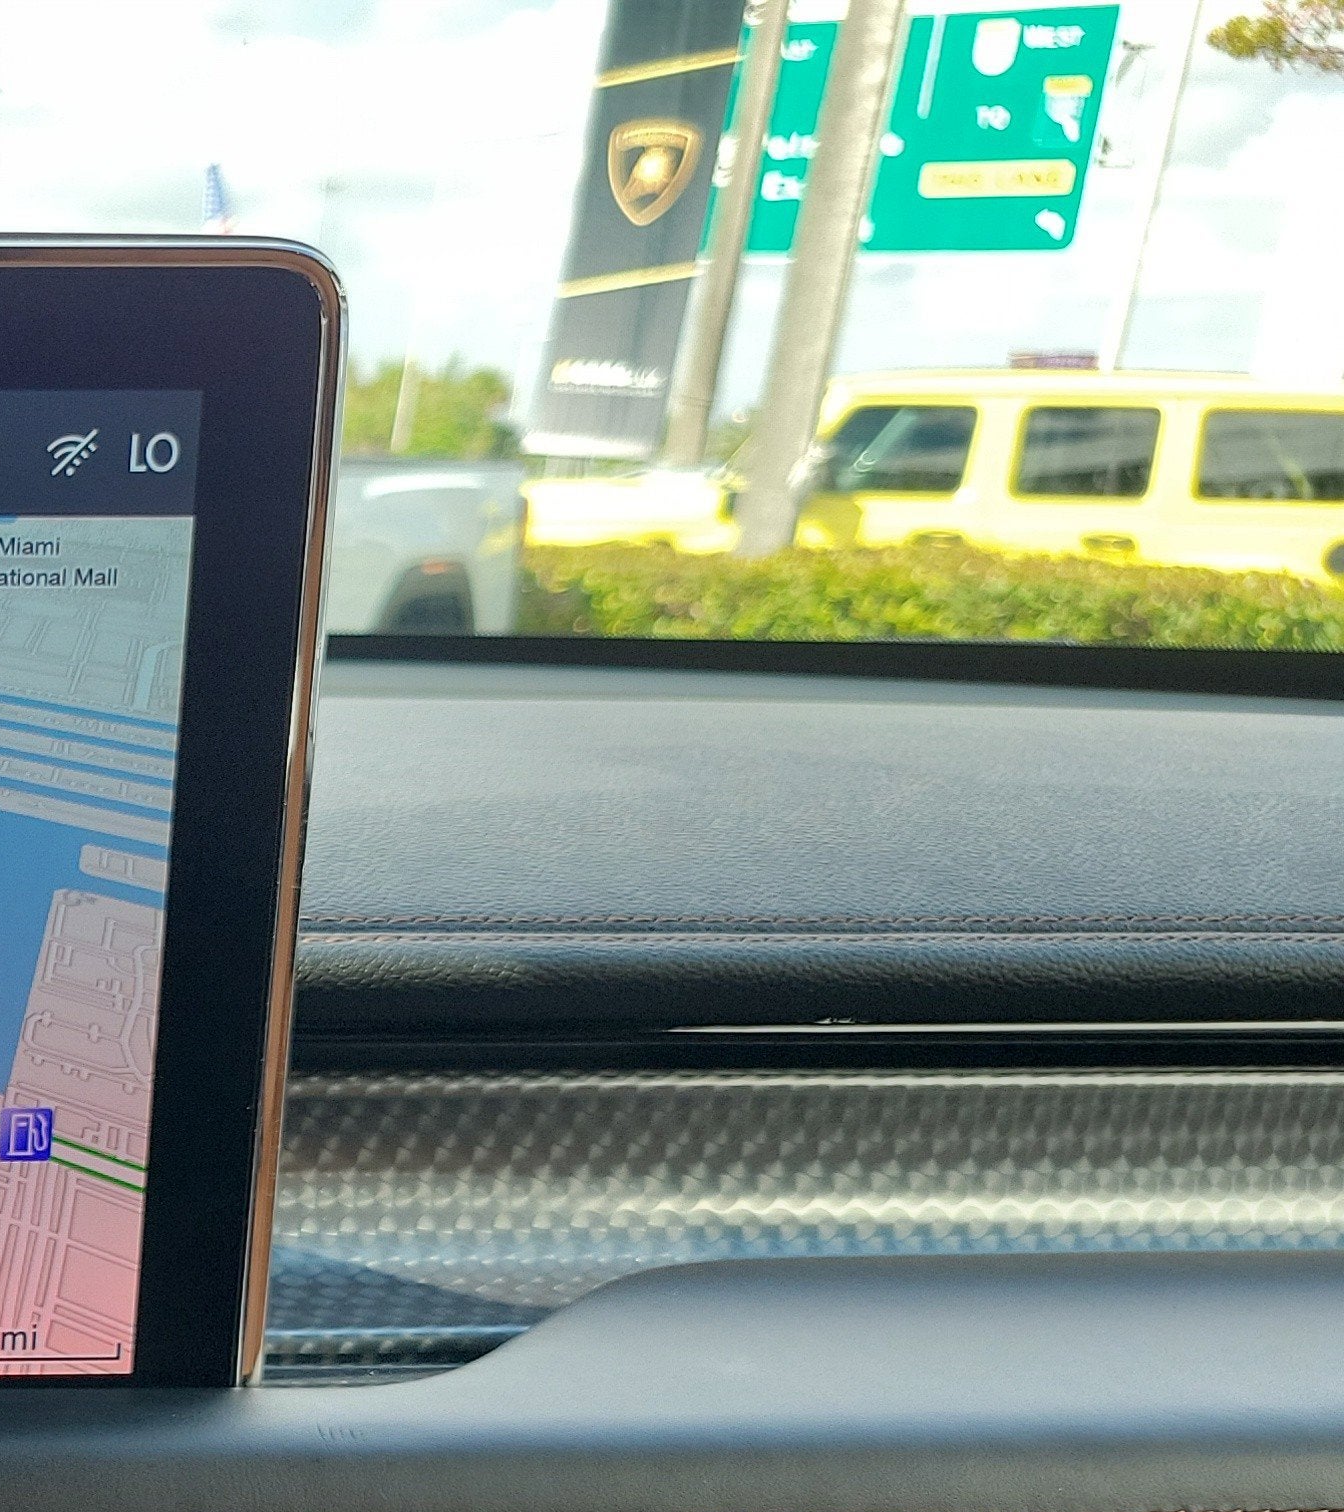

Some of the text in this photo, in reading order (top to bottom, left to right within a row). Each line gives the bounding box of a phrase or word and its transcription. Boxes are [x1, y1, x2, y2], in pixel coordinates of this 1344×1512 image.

[128, 432, 180, 474] LO
[74, 568, 118, 588] Mall
[0, 1324, 38, 1352] mi
